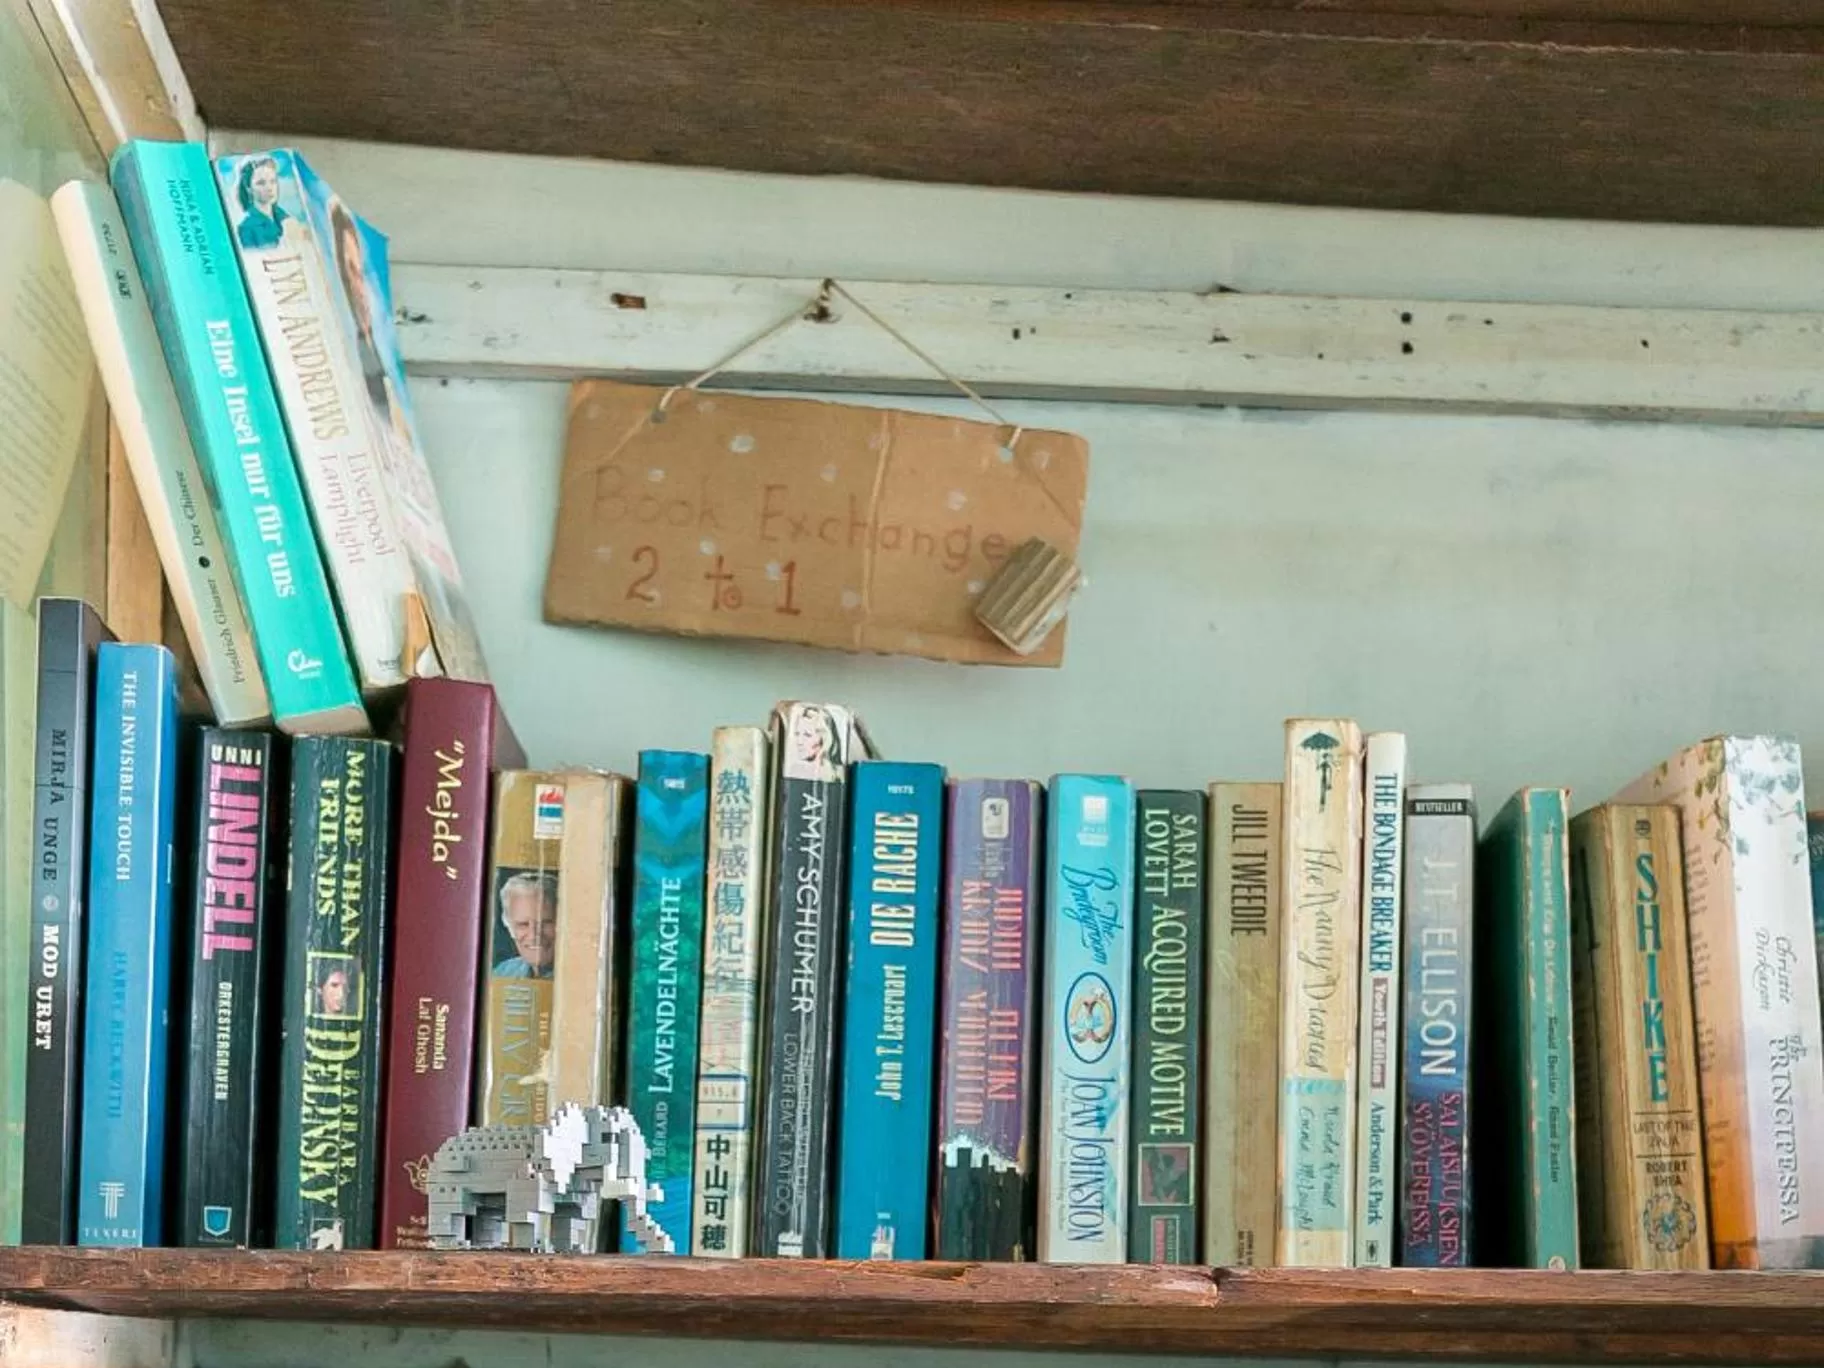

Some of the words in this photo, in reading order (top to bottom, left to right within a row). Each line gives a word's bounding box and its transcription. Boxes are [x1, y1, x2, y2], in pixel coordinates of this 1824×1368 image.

[166, 179, 193, 253] HOFFMANN
[206, 320, 238, 381] Eine
[221, 384, 259, 449] Insel
[240, 447, 272, 493] nur
[347, 451, 396, 556] Liverpool
[252, 491, 286, 541] für
[319, 455, 361, 564] Lamplight
[591, 465, 721, 532] Book
[760, 484, 1009, 573] Exchange
[267, 544, 296, 599] uns
[626, 545, 660, 602] 2
[704, 555, 744, 611] to
[775, 560, 802, 616] 1
[121, 670, 139, 710] THE
[217, 625, 245, 684] Friedrich
[48, 729, 67, 806] MIRJA
[118, 715, 136, 807] INVISIBLE
[1373, 773, 1398, 809] THE
[343, 749, 366, 848] MORE
[797, 792, 825, 856] AMY
[1230, 804, 1268, 844] JILL
[41, 818, 60, 882] UNGE
[115, 814, 133, 881] TOUCH
[202, 764, 261, 961] LINDELL
[315, 777, 339, 917] FRIENDS
[1144, 809, 1171, 898] LOVETT
[1172, 814, 1198, 889] SARAH
[1297, 847, 1343, 886] The
[1371, 813, 1397, 892] BONDAGE
[339, 857, 365, 948] THAN
[1097, 900, 1124, 940] The
[1230, 853, 1267, 937] TWEEDIE
[1297, 889, 1342, 974] Nanny
[789, 866, 822, 1013] SCHUMER
[1143, 904, 1188, 1035] ACQUIRED
[1369, 896, 1395, 973] BREAKER
[111, 951, 129, 1015] HARRY
[415, 996, 433, 1020] Lal
[1371, 983, 1388, 1027] Youth
[1635, 853, 1668, 1103] SHIKE
[107, 1020, 126, 1120] BECKWITH
[214, 982, 233, 1101] ORKESTERGRAVEN
[413, 1024, 432, 1073] Ghosh
[779, 1032, 798, 1095] LOWER
[1370, 1029, 1387, 1084] Edition
[778, 1098, 796, 1145] BACK
[1058, 1067, 1116, 1131] JOAN
[1149, 1041, 1187, 1136] MOTIVE
[1774, 1036, 1807, 1226] PRINCIPESSA
[773, 1150, 794, 1216] TATTOO
[1063, 1132, 1117, 1243] JOHNSTON
[1437, 1093, 1462, 1265] SALAISUUKSIEN
